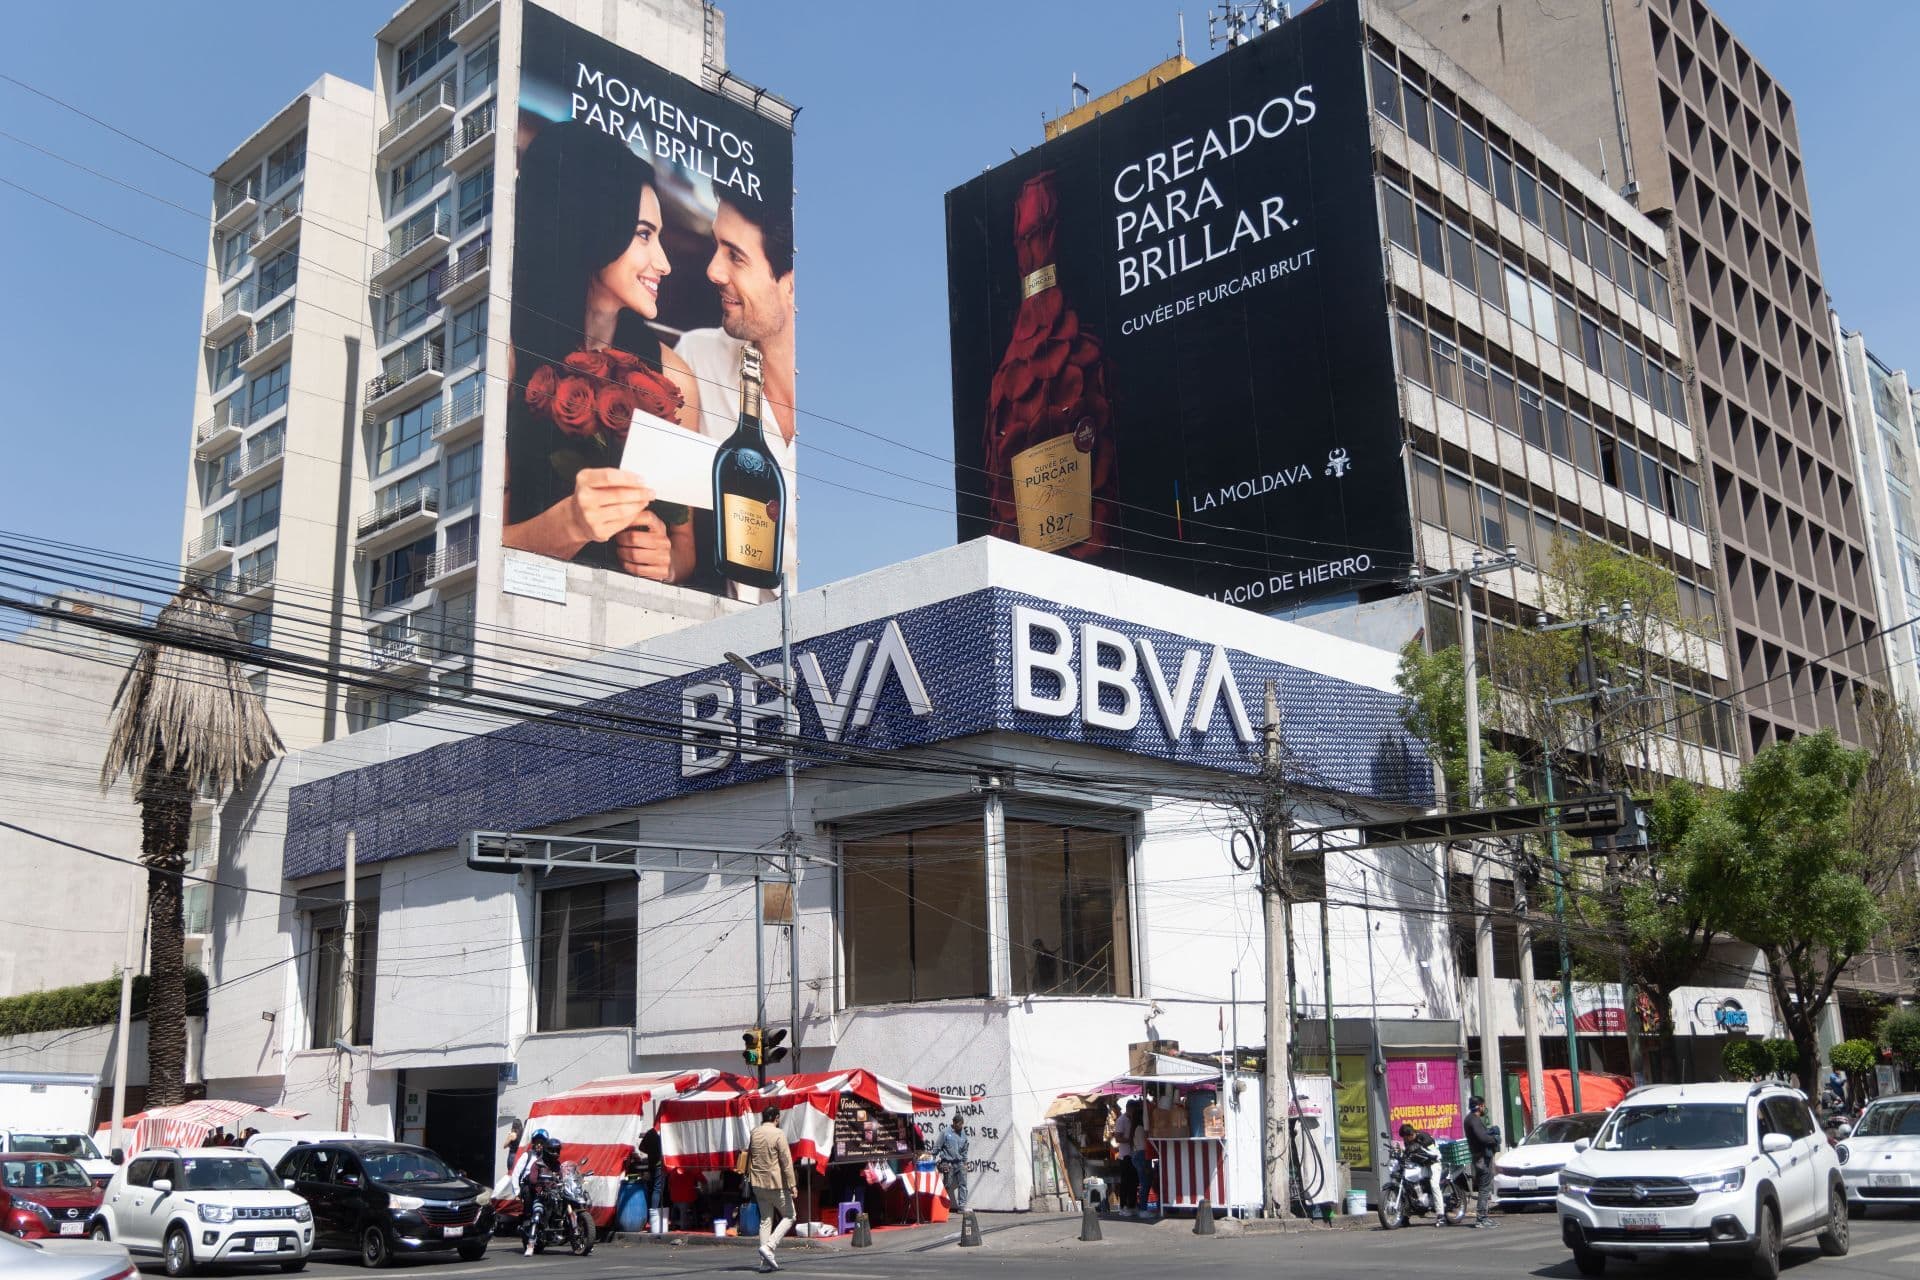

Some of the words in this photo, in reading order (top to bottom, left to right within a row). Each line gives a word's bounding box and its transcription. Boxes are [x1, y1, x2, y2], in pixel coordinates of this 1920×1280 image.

[577, 61, 755, 167] MOMENTOS
[570, 91, 649, 151] PARA
[654, 129, 764, 203] BRILLAR
[1113, 84, 1317, 203] CREADOS
[1115, 176, 1225, 252] PARA
[1117, 195, 1300, 297] BRILLAR.
[1121, 304, 1174, 336] CUVÉE
[1175, 295, 1196, 316] DE
[1198, 267, 1267, 307] PURCARI
[1269, 248, 1316, 281] BRUT
[1025, 460, 1079, 488] PURCARI
[1192, 492, 1217, 513] LA
[1220, 464, 1313, 506] MOLDAVA
[732, 512, 769, 529] PURCARI
[1039, 513, 1074, 537] 1827
[739, 543, 763, 561] 1827
[1205, 581, 1264, 604] ACIO
[1269, 573, 1295, 595] DE
[1299, 554, 1376, 588] HIERRO.
[680, 619, 934, 778] BBVA
[1012, 605, 1257, 744] BBVA
[955, 1103, 985, 1117] AHORA
[970, 1083, 986, 1097] LOS
[1425, 1103, 1458, 1117] MEJORES
[981, 1126, 1000, 1140] SER
